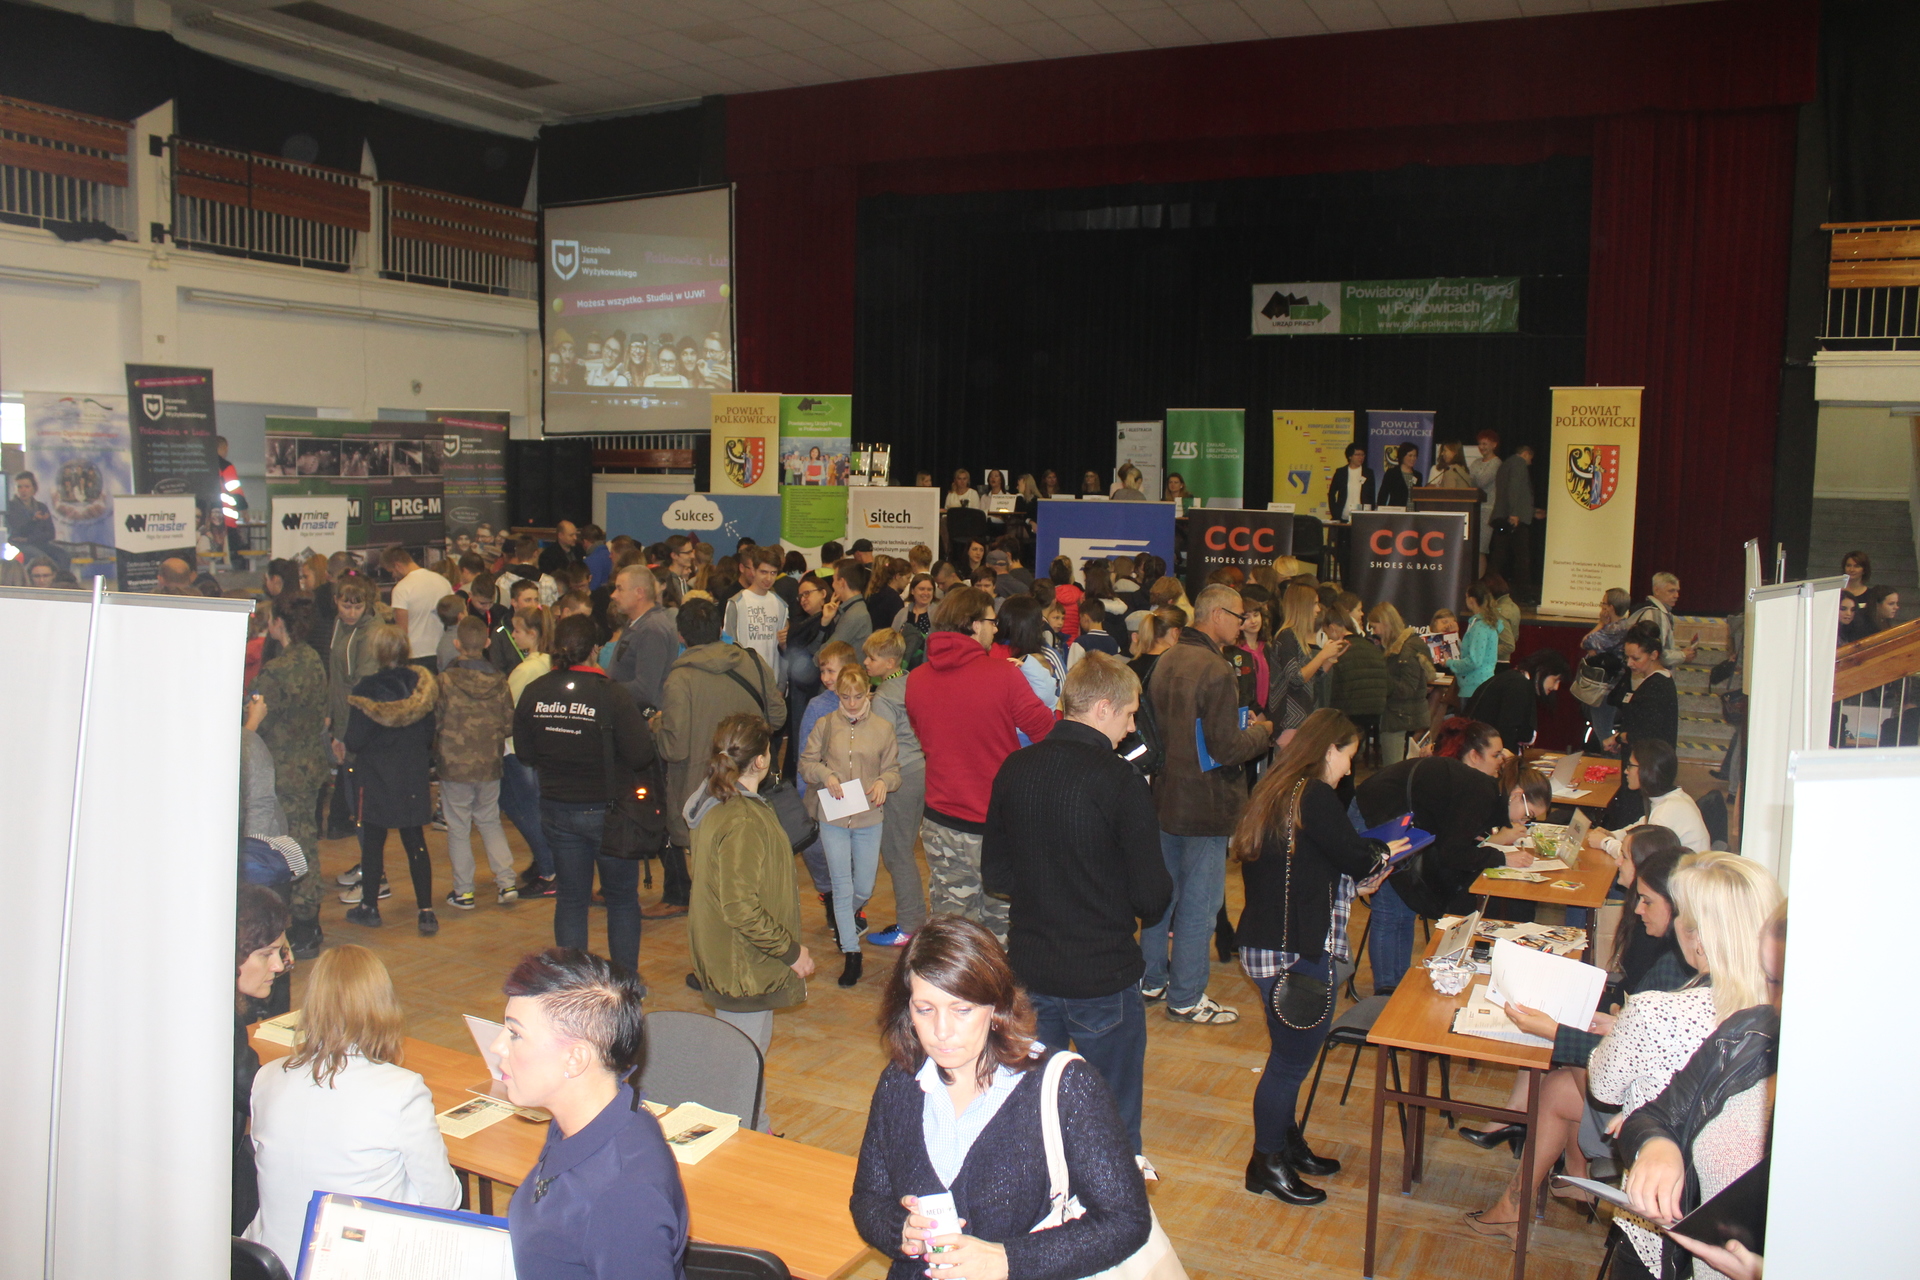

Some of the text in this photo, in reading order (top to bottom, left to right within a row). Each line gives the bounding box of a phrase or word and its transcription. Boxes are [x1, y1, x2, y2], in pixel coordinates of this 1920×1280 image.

[581, 245, 610, 254] Uczelnia
[582, 256, 598, 264] Jana
[582, 266, 638, 278] Wyżykowskiego
[1346, 283, 1514, 300] Powiatowy Urząd Pracy
[577, 298, 605, 308] Możesz
[607, 294, 644, 306] wszystko.
[646, 292, 674, 303] Studiuj
[684, 290, 705, 298] UJW!
[1378, 301, 1480, 314] w Polkowicach
[1272, 320, 1293, 328] URZĄD
[726, 407, 764, 415] POWIAT
[1571, 405, 1621, 416] POWIAT
[714, 415, 776, 424] POLKOWICKI
[1555, 416, 1636, 427] POLKOWICKI
[1370, 429, 1432, 437] POLKOWICKI
[1172, 442, 1198, 458] ZUS
[391, 498, 441, 515] PRG-M
[148, 510, 176, 521] mine
[303, 510, 329, 520] mine
[675, 510, 714, 521] Sukces
[871, 509, 911, 523] sitech
[147, 521, 187, 532] master
[301, 520, 338, 530] master
[1205, 525, 1275, 553] CCC
[1370, 529, 1444, 557] CCC
[1205, 556, 1236, 564] SHOES
[1248, 558, 1273, 566] BAGS
[1370, 561, 1403, 569] SHOES
[748, 623, 773, 632] Be The
[748, 632, 774, 640] Winner
[535, 702, 596, 717] Radio Elka
